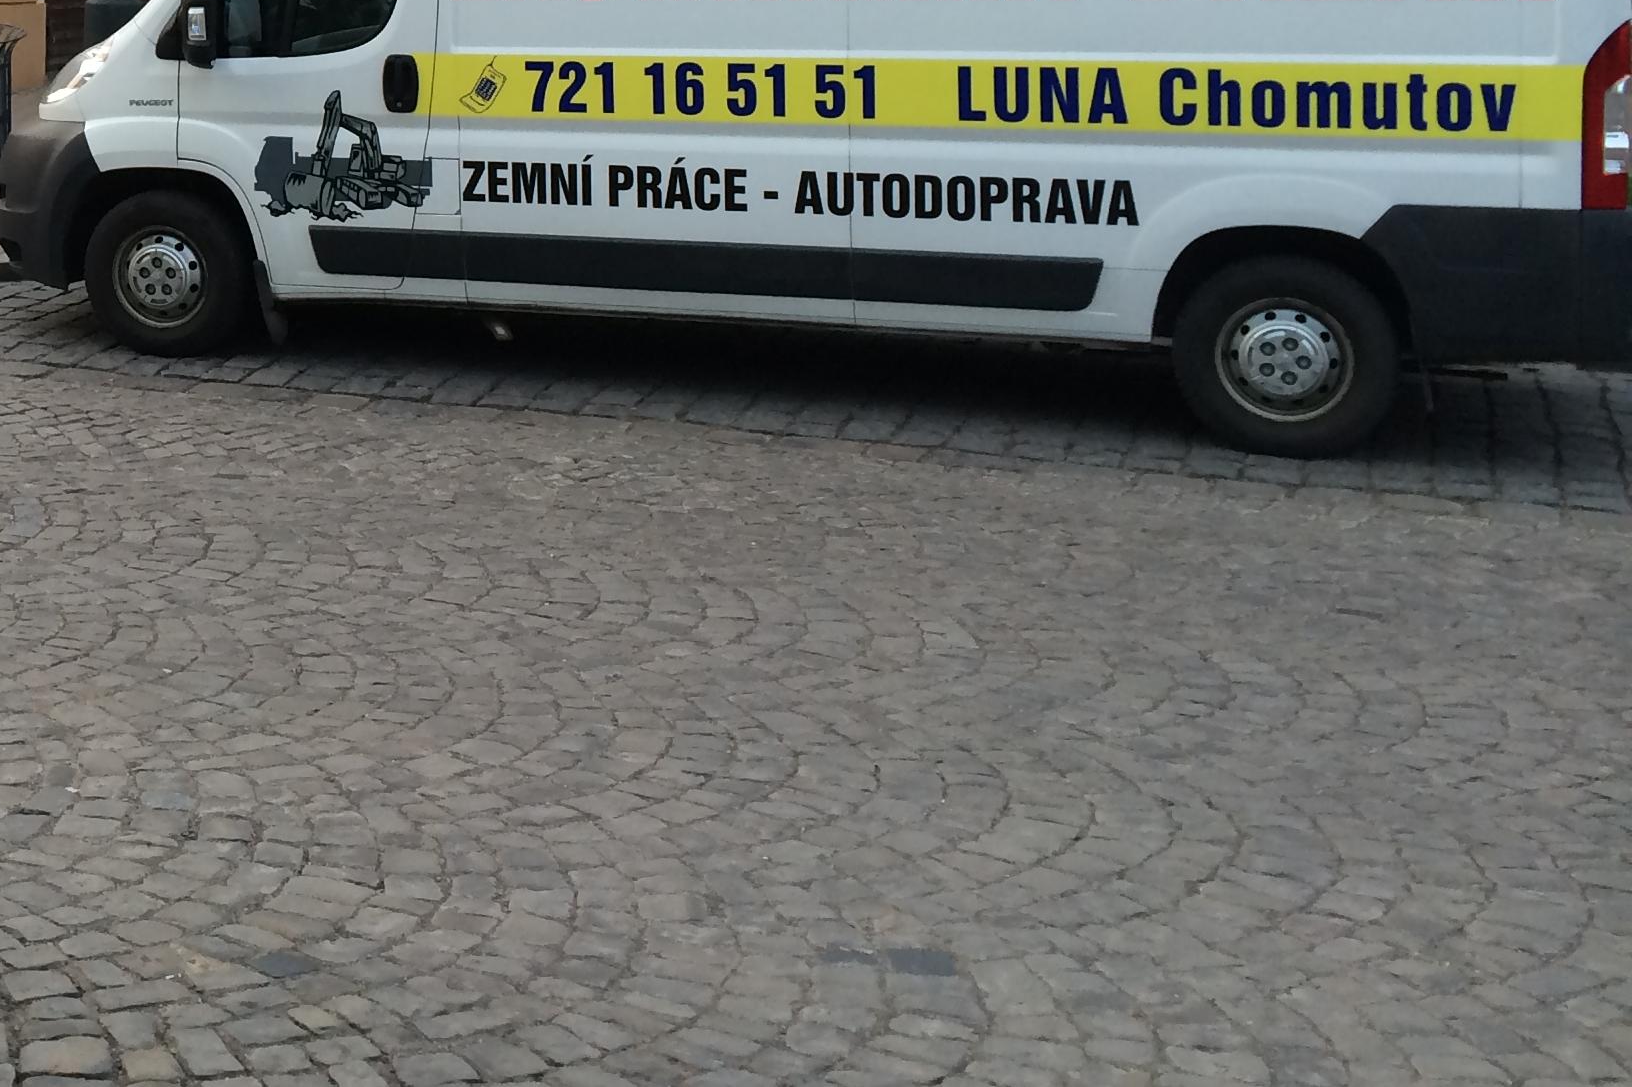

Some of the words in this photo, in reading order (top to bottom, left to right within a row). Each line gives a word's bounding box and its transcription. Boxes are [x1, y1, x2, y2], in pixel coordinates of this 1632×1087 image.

[524, 60, 615, 114] 721
[643, 61, 705, 116] 16
[726, 62, 786, 118] 51
[814, 64, 876, 120] 51
[957, 65, 1129, 125] LUNA
[1158, 67, 1517, 132] Chomutov
[462, 154, 594, 206] ZEMNÍ
[608, 156, 748, 212] PRÁCE
[794, 170, 1140, 227] AUTODOPRAVA
